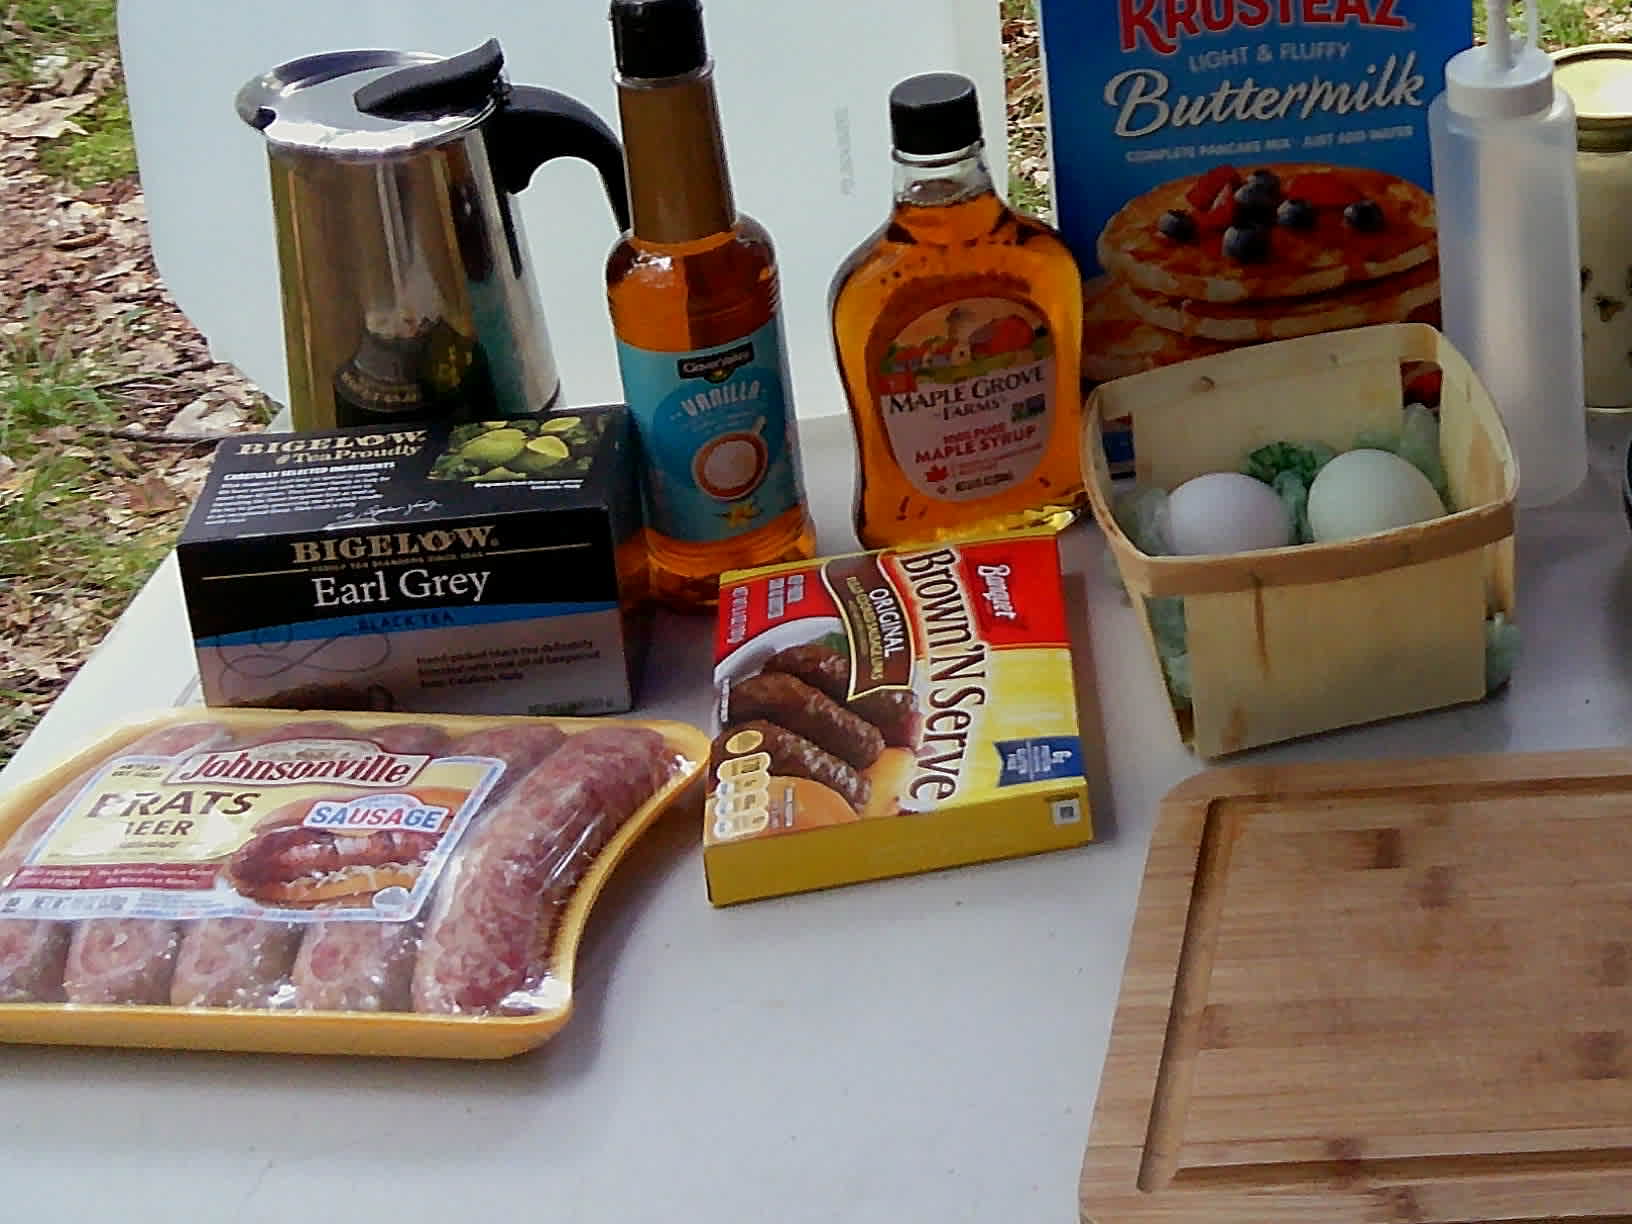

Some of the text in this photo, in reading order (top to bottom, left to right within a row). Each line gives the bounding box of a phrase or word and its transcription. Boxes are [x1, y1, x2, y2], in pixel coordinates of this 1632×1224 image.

[1188, 41, 1350, 72] LIGHT & FLUFFY
[1104, 51, 1425, 139] Buttermilk
[889, 365, 1045, 414] MAPLE GROVE
[234, 429, 428, 456] BIGELOW
[331, 444, 424, 463] Proudly
[914, 439, 976, 464] MAPLE
[980, 425, 1037, 451] SYRUP
[290, 526, 496, 564] BIGELOW
[311, 568, 491, 608] Earl Grey
[977, 564, 1018, 620] Banquet
[358, 608, 455, 632] BLACK TEA
[868, 588, 905, 658] ORIGINAL
[908, 684, 986, 803] Serve
[180, 751, 412, 784] Johnsonville
[86, 790, 262, 818] BRATS
[310, 805, 443, 829] SAUSAGE
